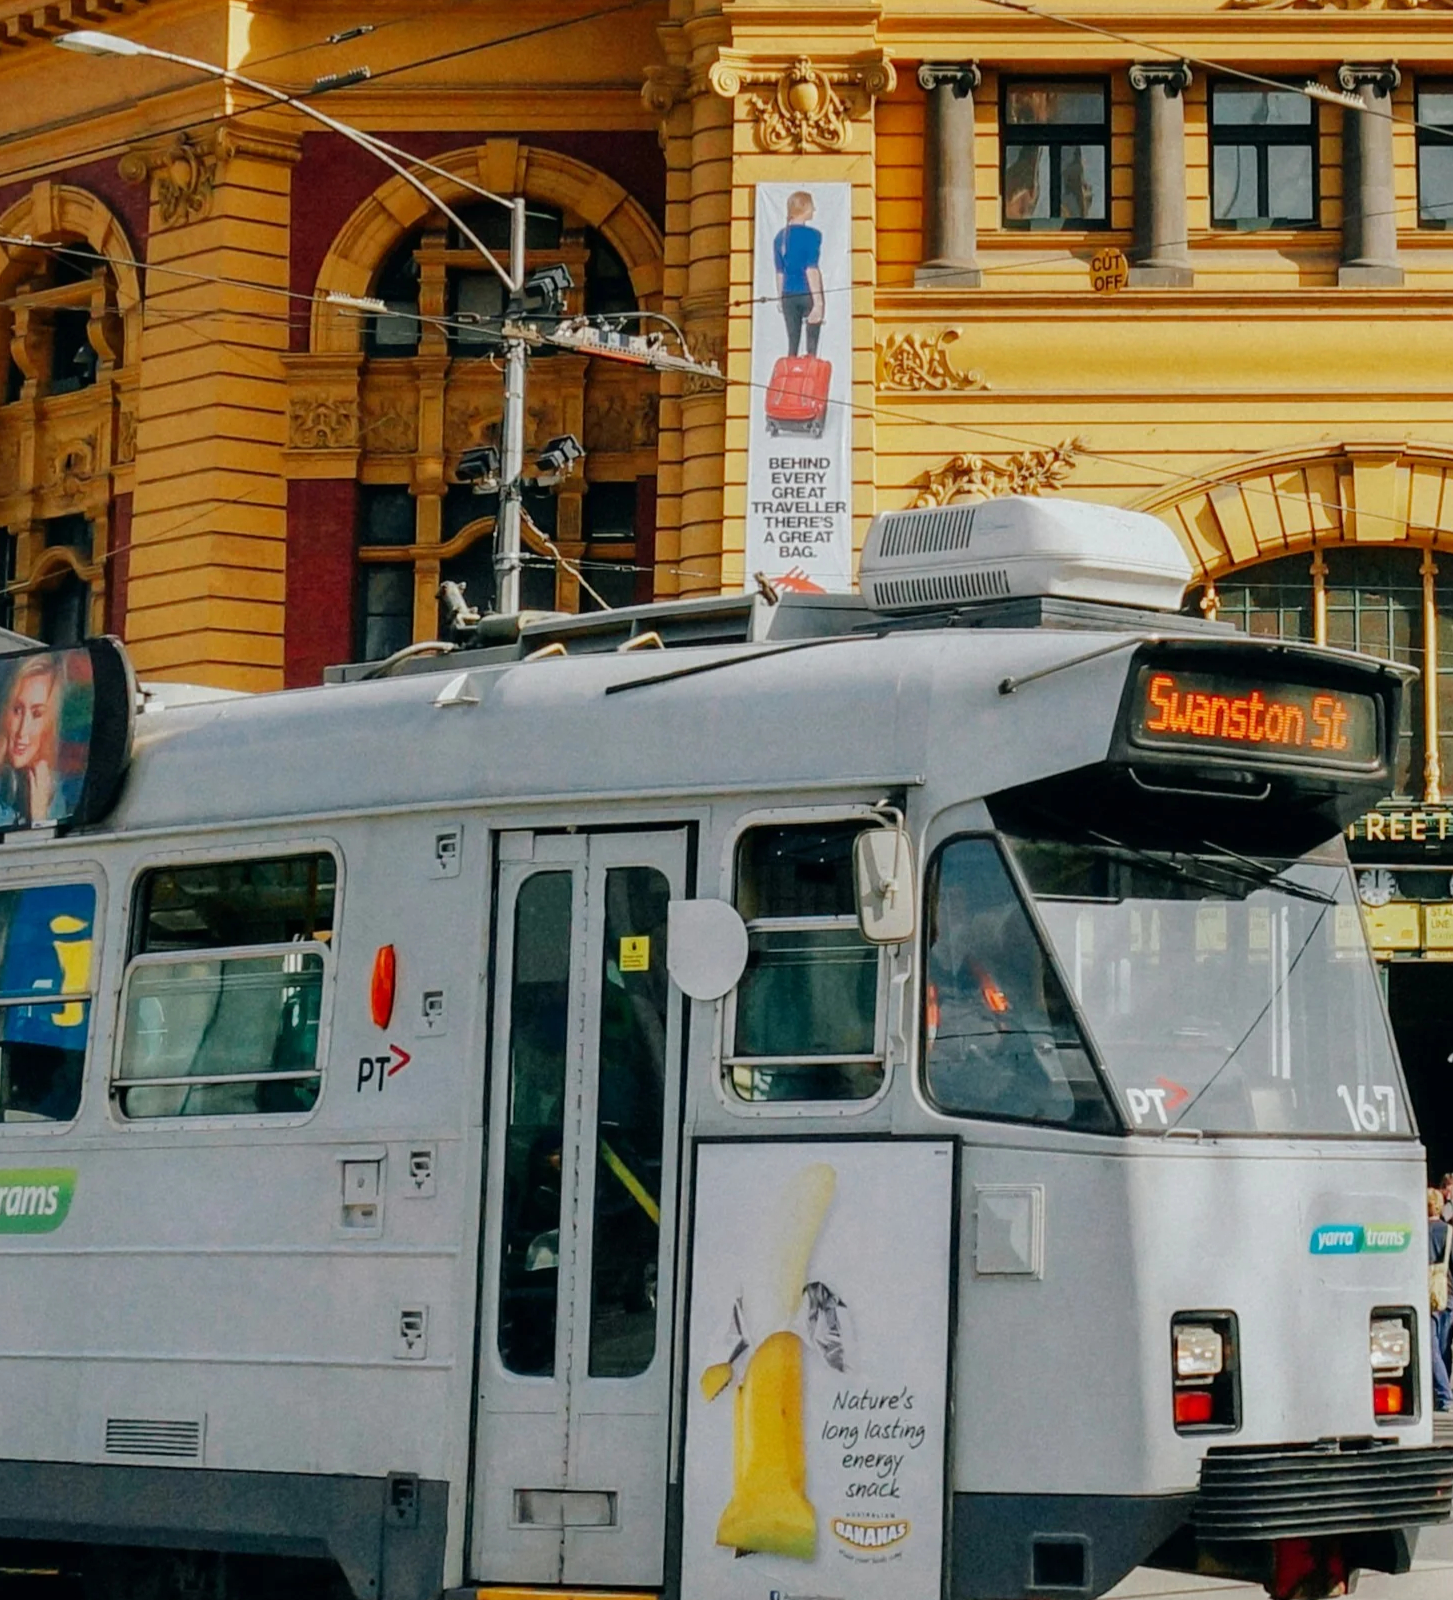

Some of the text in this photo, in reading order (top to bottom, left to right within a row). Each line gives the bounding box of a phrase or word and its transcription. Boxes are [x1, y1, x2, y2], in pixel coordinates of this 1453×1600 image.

[1092, 255, 1121, 272] CUT
[1094, 274, 1123, 291] OFF
[769, 458, 830, 469] BEHIND
[771, 472, 827, 484] EVERY
[772, 487, 827, 499] GREAT
[751, 502, 847, 514] TRAVELLER
[764, 516, 834, 528] THERE'S
[763, 531, 834, 543] A GREAT
[779, 546, 817, 558] BAG.
[1148, 676, 1348, 749] Swanston St
[1431, 919, 1450, 929] LINE
[1337, 1084, 1396, 1132] 167
[1317, 1226, 1404, 1250] yarra trams
[833, 1385, 915, 1411] Nature's
[822, 1419, 926, 1450] long lasting
[842, 1452, 905, 1478] energy
[846, 1478, 901, 1499] snack
[835, 1521, 907, 1547] BANANAS
